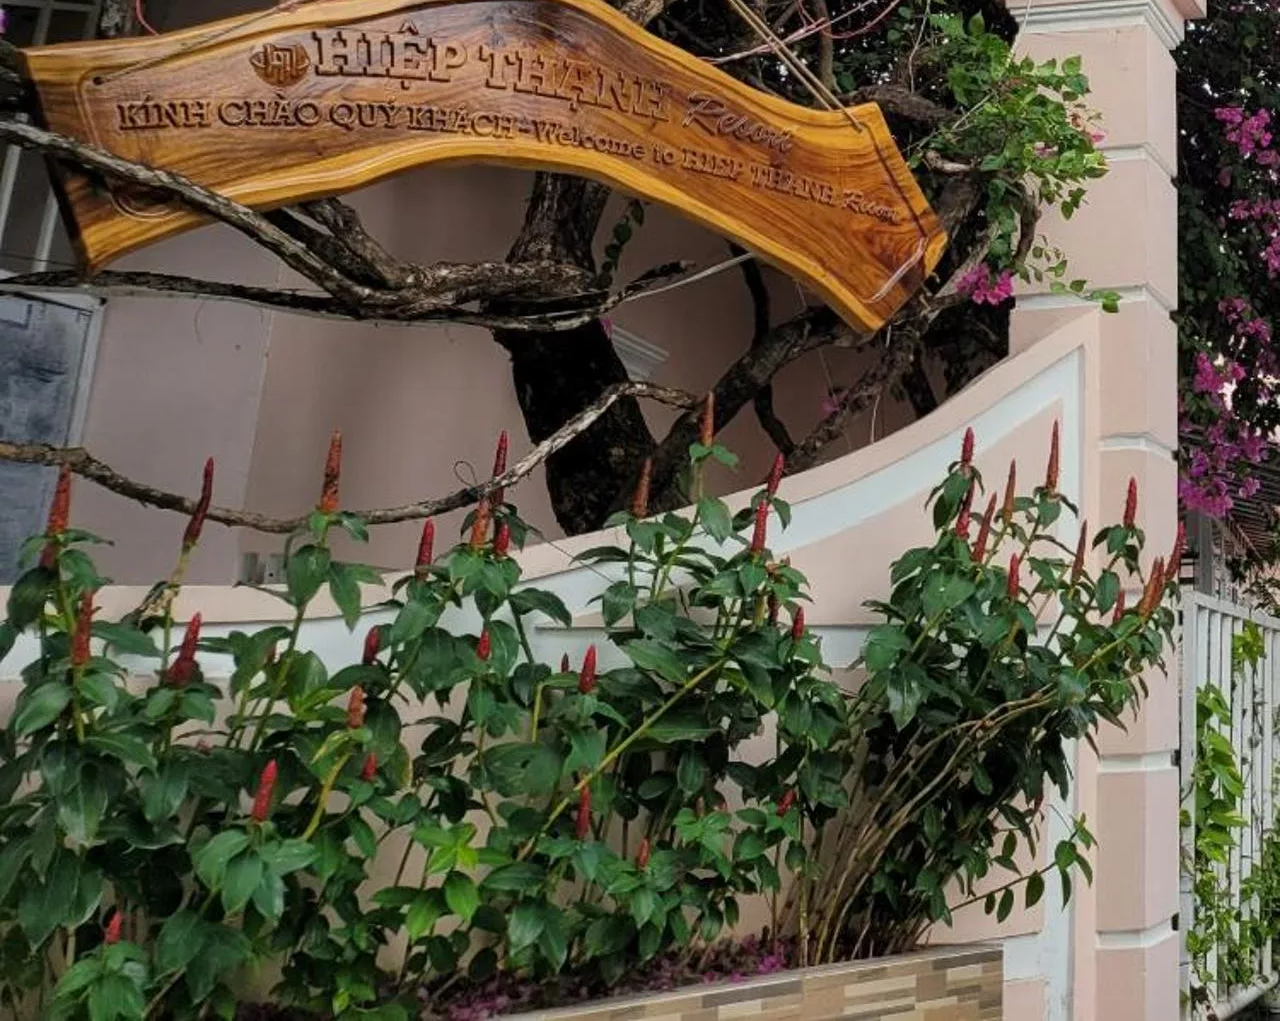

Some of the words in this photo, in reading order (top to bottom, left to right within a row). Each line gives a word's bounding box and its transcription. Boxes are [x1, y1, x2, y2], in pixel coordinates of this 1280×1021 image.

[116, 94, 211, 130] KÍNH
[217, 91, 321, 127] CHÀO
[652, 141, 675, 165] to
[311, 20, 469, 91] HIỆP
[682, 90, 794, 153] Resort
